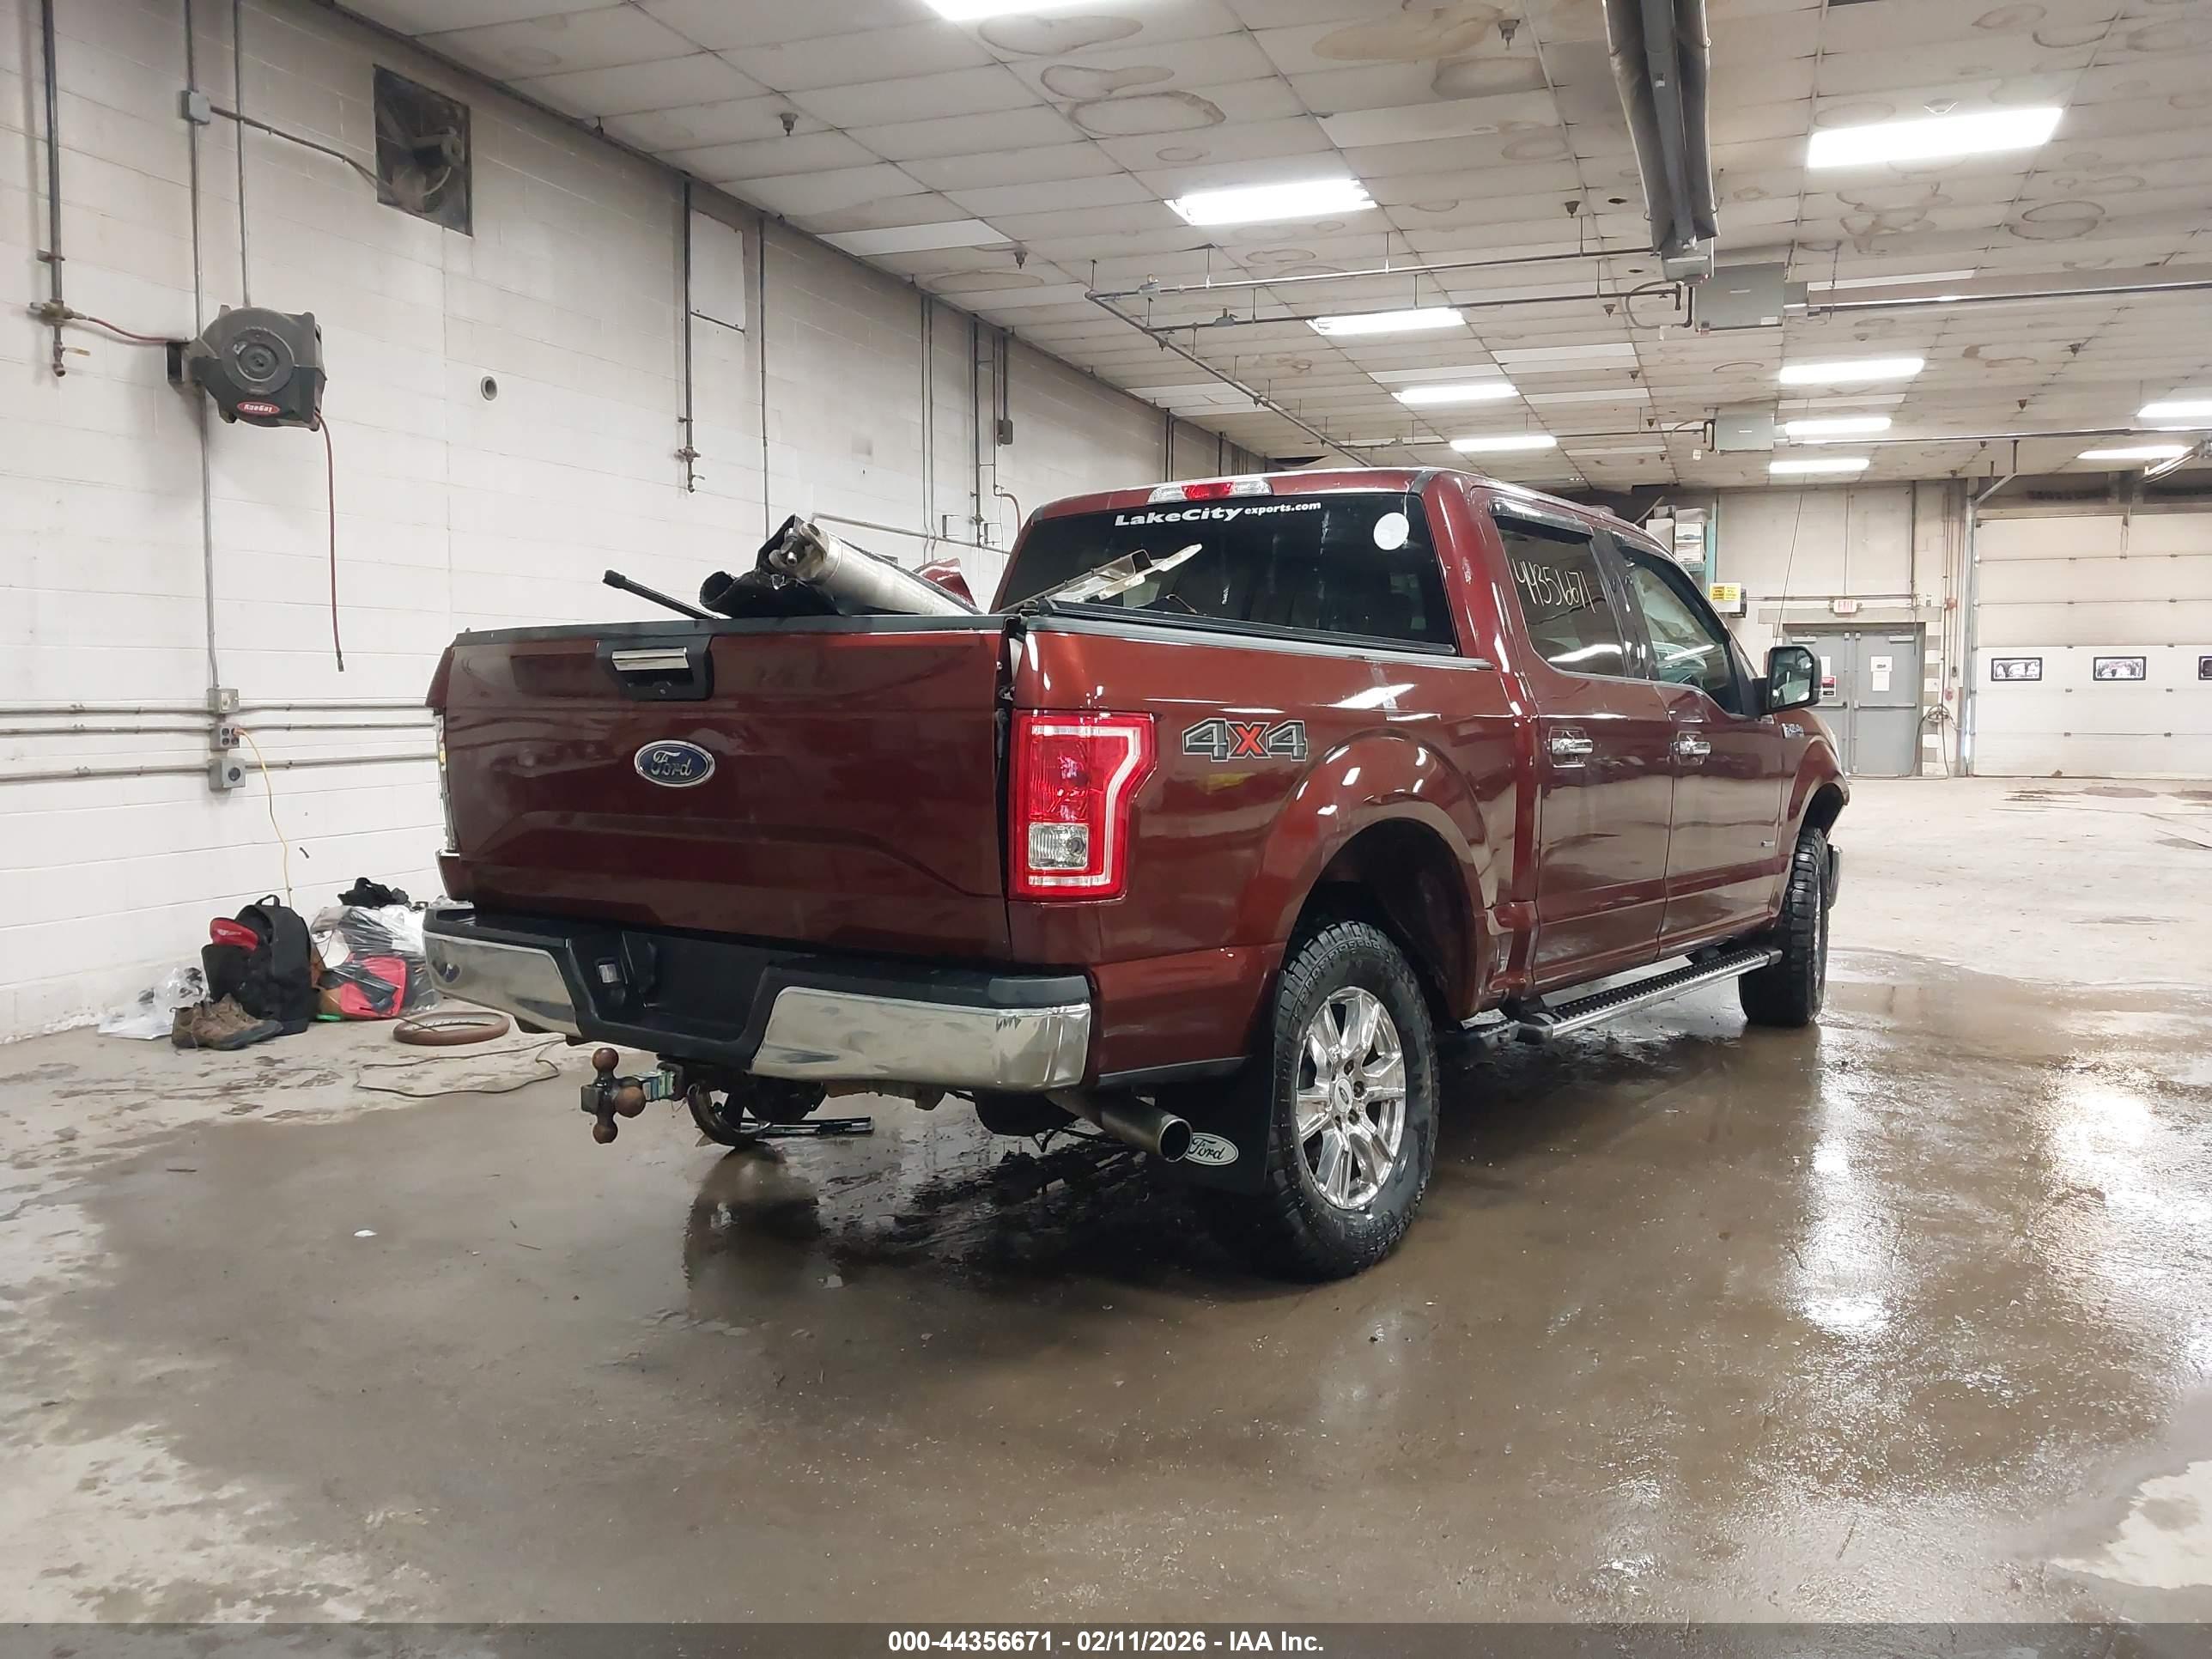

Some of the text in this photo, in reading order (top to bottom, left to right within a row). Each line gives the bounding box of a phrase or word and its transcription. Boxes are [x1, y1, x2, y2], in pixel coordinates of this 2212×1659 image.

[1511, 557, 1597, 614] 44356671
[650, 750, 693, 776] Ford
[1188, 1137, 1226, 1160] Ford
